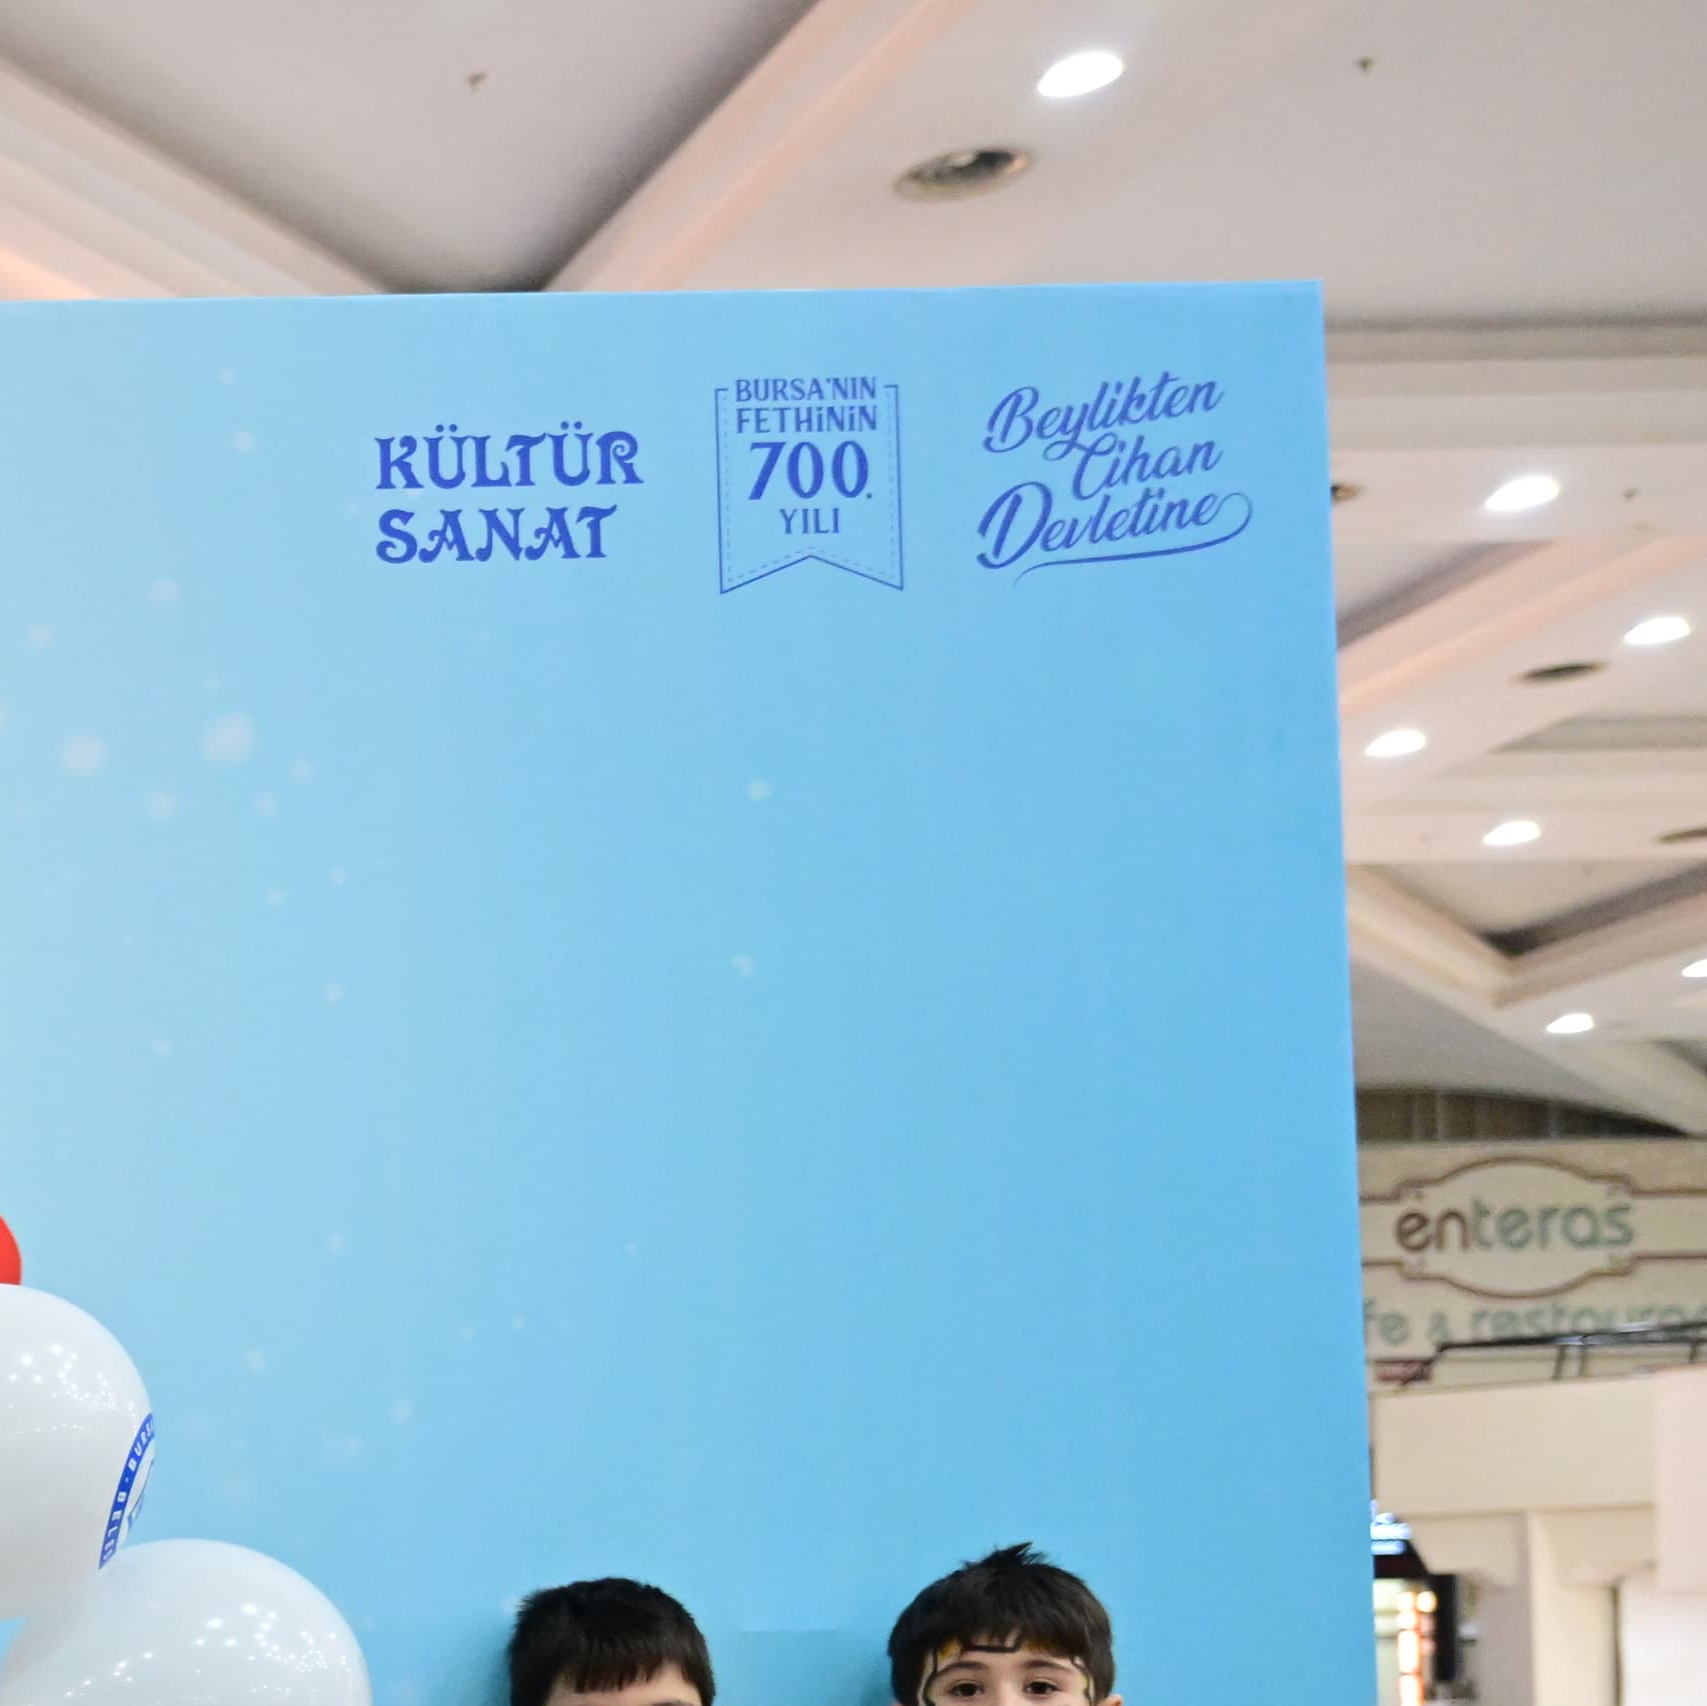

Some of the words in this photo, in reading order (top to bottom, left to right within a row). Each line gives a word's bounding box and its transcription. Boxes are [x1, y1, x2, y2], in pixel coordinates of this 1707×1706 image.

[735, 375, 878, 404] BURSA'NIN
[983, 369, 1226, 462] Beylikten
[375, 422, 645, 490] KÜLTÜR
[748, 441, 874, 504] 700.
[1069, 431, 1223, 504] Cihan
[376, 502, 619, 566] SANAT
[780, 507, 842, 536] YILI
[976, 481, 1254, 576] Devletine
[1394, 1199, 1635, 1253] enteras
